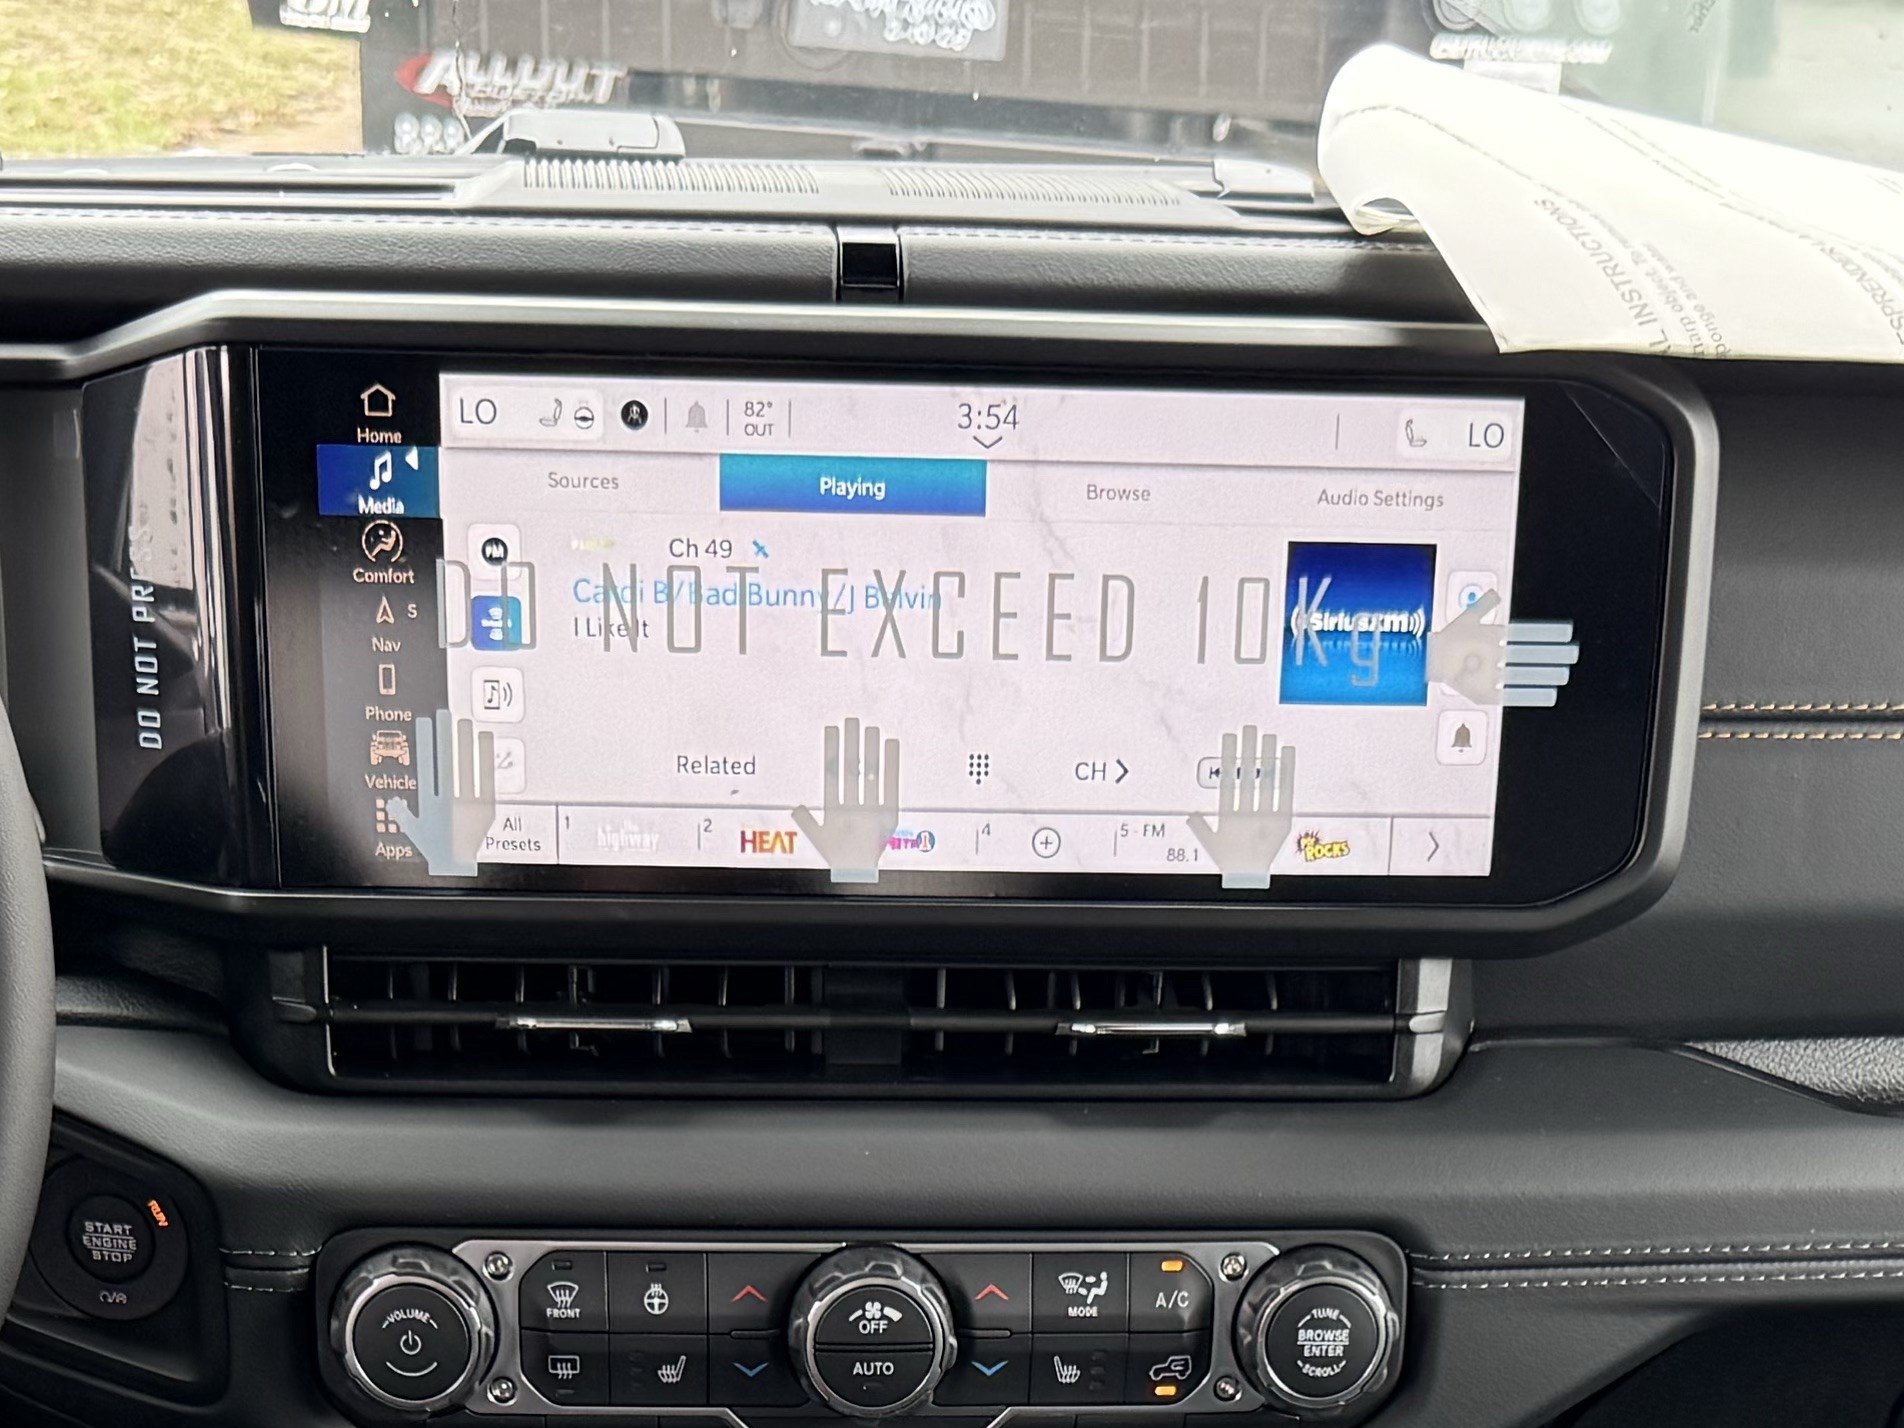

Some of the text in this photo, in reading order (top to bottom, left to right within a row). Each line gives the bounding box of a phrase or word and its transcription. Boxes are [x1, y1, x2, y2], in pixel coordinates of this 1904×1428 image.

[459, 397, 774, 425] LO 82°
[956, 402, 1021, 433] 3:54
[356, 426, 403, 445] Home
[744, 422, 775, 438] OUT
[1468, 422, 1505, 450] LO
[547, 471, 620, 491] Sources
[818, 476, 887, 502] Playing
[1085, 482, 1152, 504] Browse
[1317, 487, 1446, 512] Audio Settings
[357, 494, 406, 515] Media
[668, 538, 734, 560] Ch 49
[352, 567, 416, 585] Comfort
[407, 602, 418, 619] S
[602, 562, 760, 655] NOT
[820, 567, 1136, 664] EXCEED
[371, 636, 402, 653] Nav
[132, 637, 160, 696] NOT
[364, 705, 413, 723] Phone
[676, 754, 757, 777] Related
[1074, 761, 1107, 783] CH
[363, 772, 418, 792] Vehicle
[502, 816, 523, 833] All
[704, 818, 713, 834] 2
[981, 824, 991, 837] 4
[1143, 824, 1166, 838] FM
[374, 841, 414, 861] Apps
[484, 836, 543, 853] Presets
[739, 829, 797, 855] HEAT
[84, 1220, 133, 1236] START
[81, 1235, 137, 1251] ENGINE
[91, 1250, 133, 1264] STOP
[1155, 1289, 1190, 1310] A/C
[386, 1307, 432, 1325] VOLUME
[545, 1307, 582, 1320] FRONT
[1067, 1306, 1099, 1319] MODE
[858, 1320, 889, 1335] OFF
[1297, 1328, 1351, 1342] BROWSE
[1303, 1345, 1345, 1358] ENTER
[852, 1360, 895, 1377] AUTO
